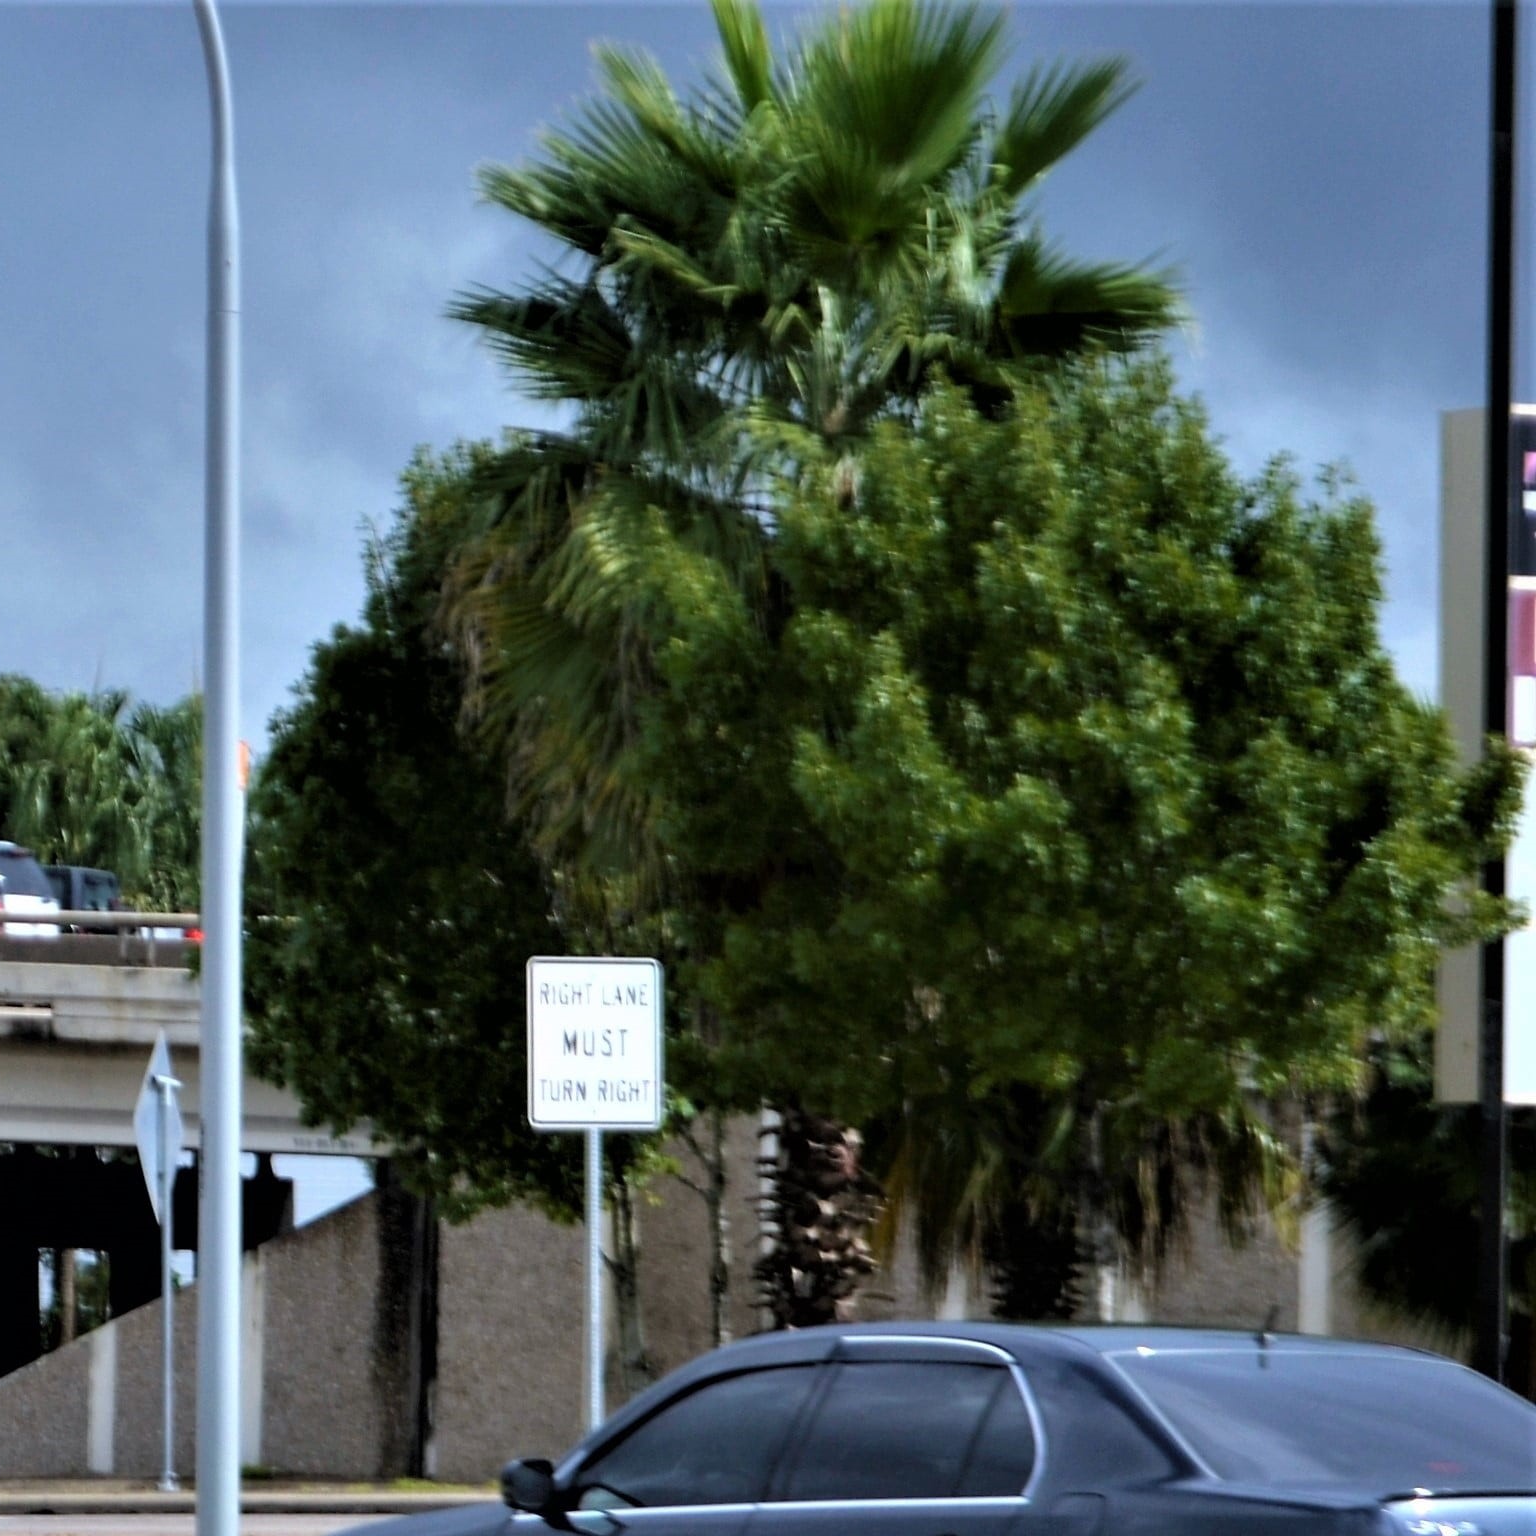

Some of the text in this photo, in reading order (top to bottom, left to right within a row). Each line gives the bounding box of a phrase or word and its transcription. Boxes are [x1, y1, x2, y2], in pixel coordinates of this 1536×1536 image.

[539, 982, 649, 1007] RIGHT LANE
[562, 1028, 629, 1057] MUST
[538, 1079, 651, 1103] TURN RIGHT
